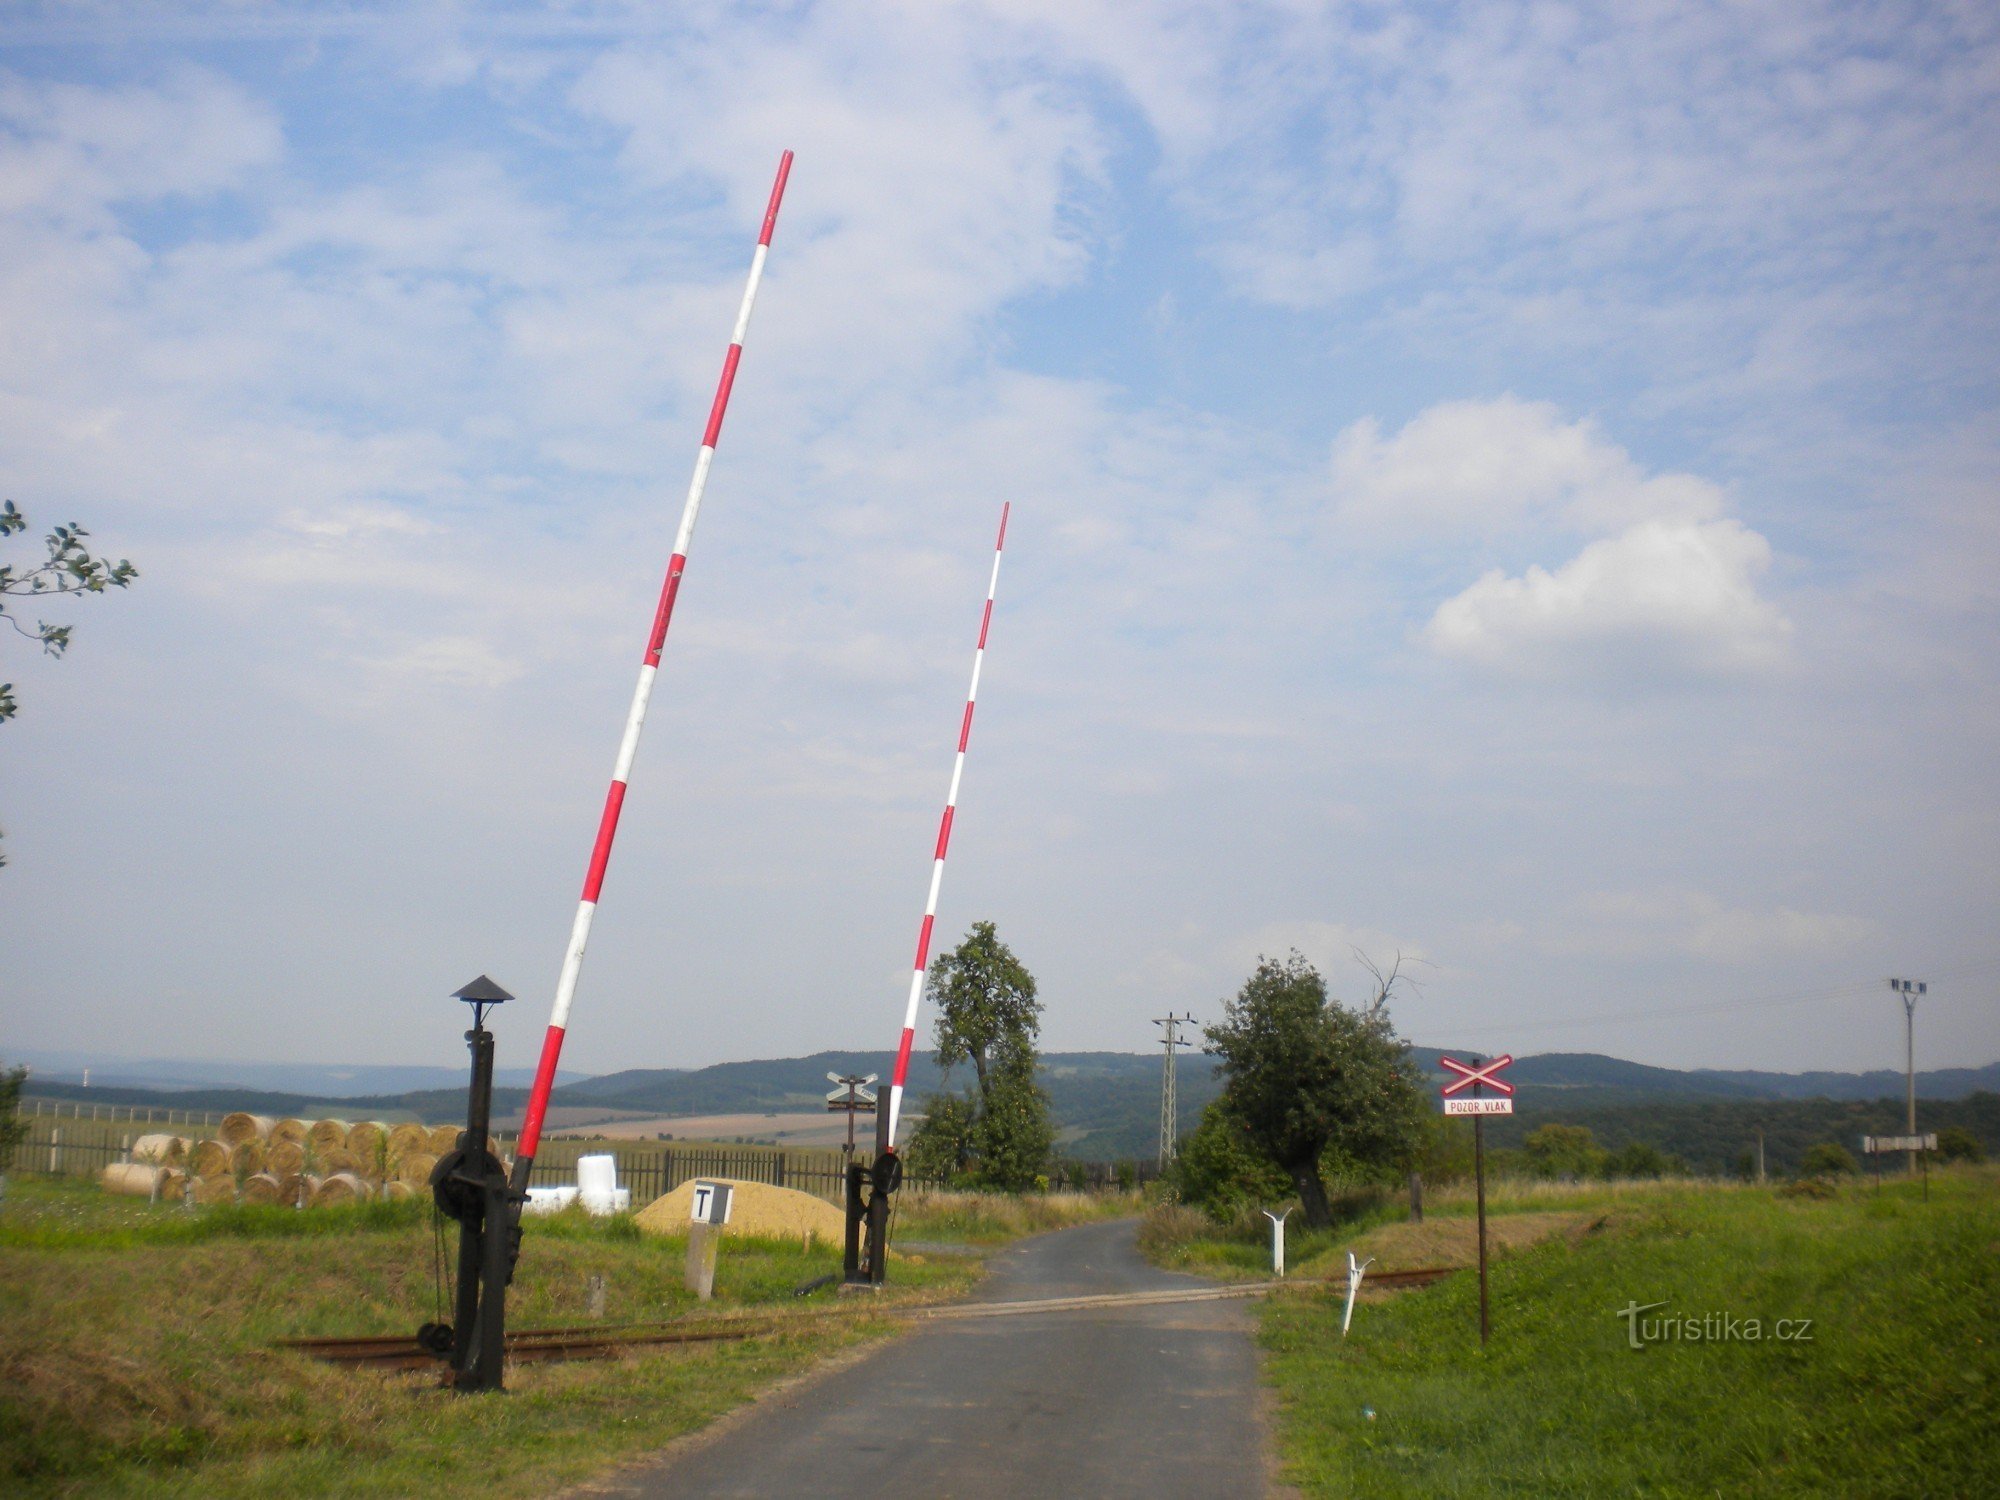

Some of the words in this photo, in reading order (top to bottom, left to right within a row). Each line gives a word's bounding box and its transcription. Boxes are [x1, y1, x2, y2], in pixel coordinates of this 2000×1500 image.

[1450, 1102, 1480, 1112] POZOR
[1484, 1101, 1506, 1112] VLAK
[696, 1189, 711, 1218] T
